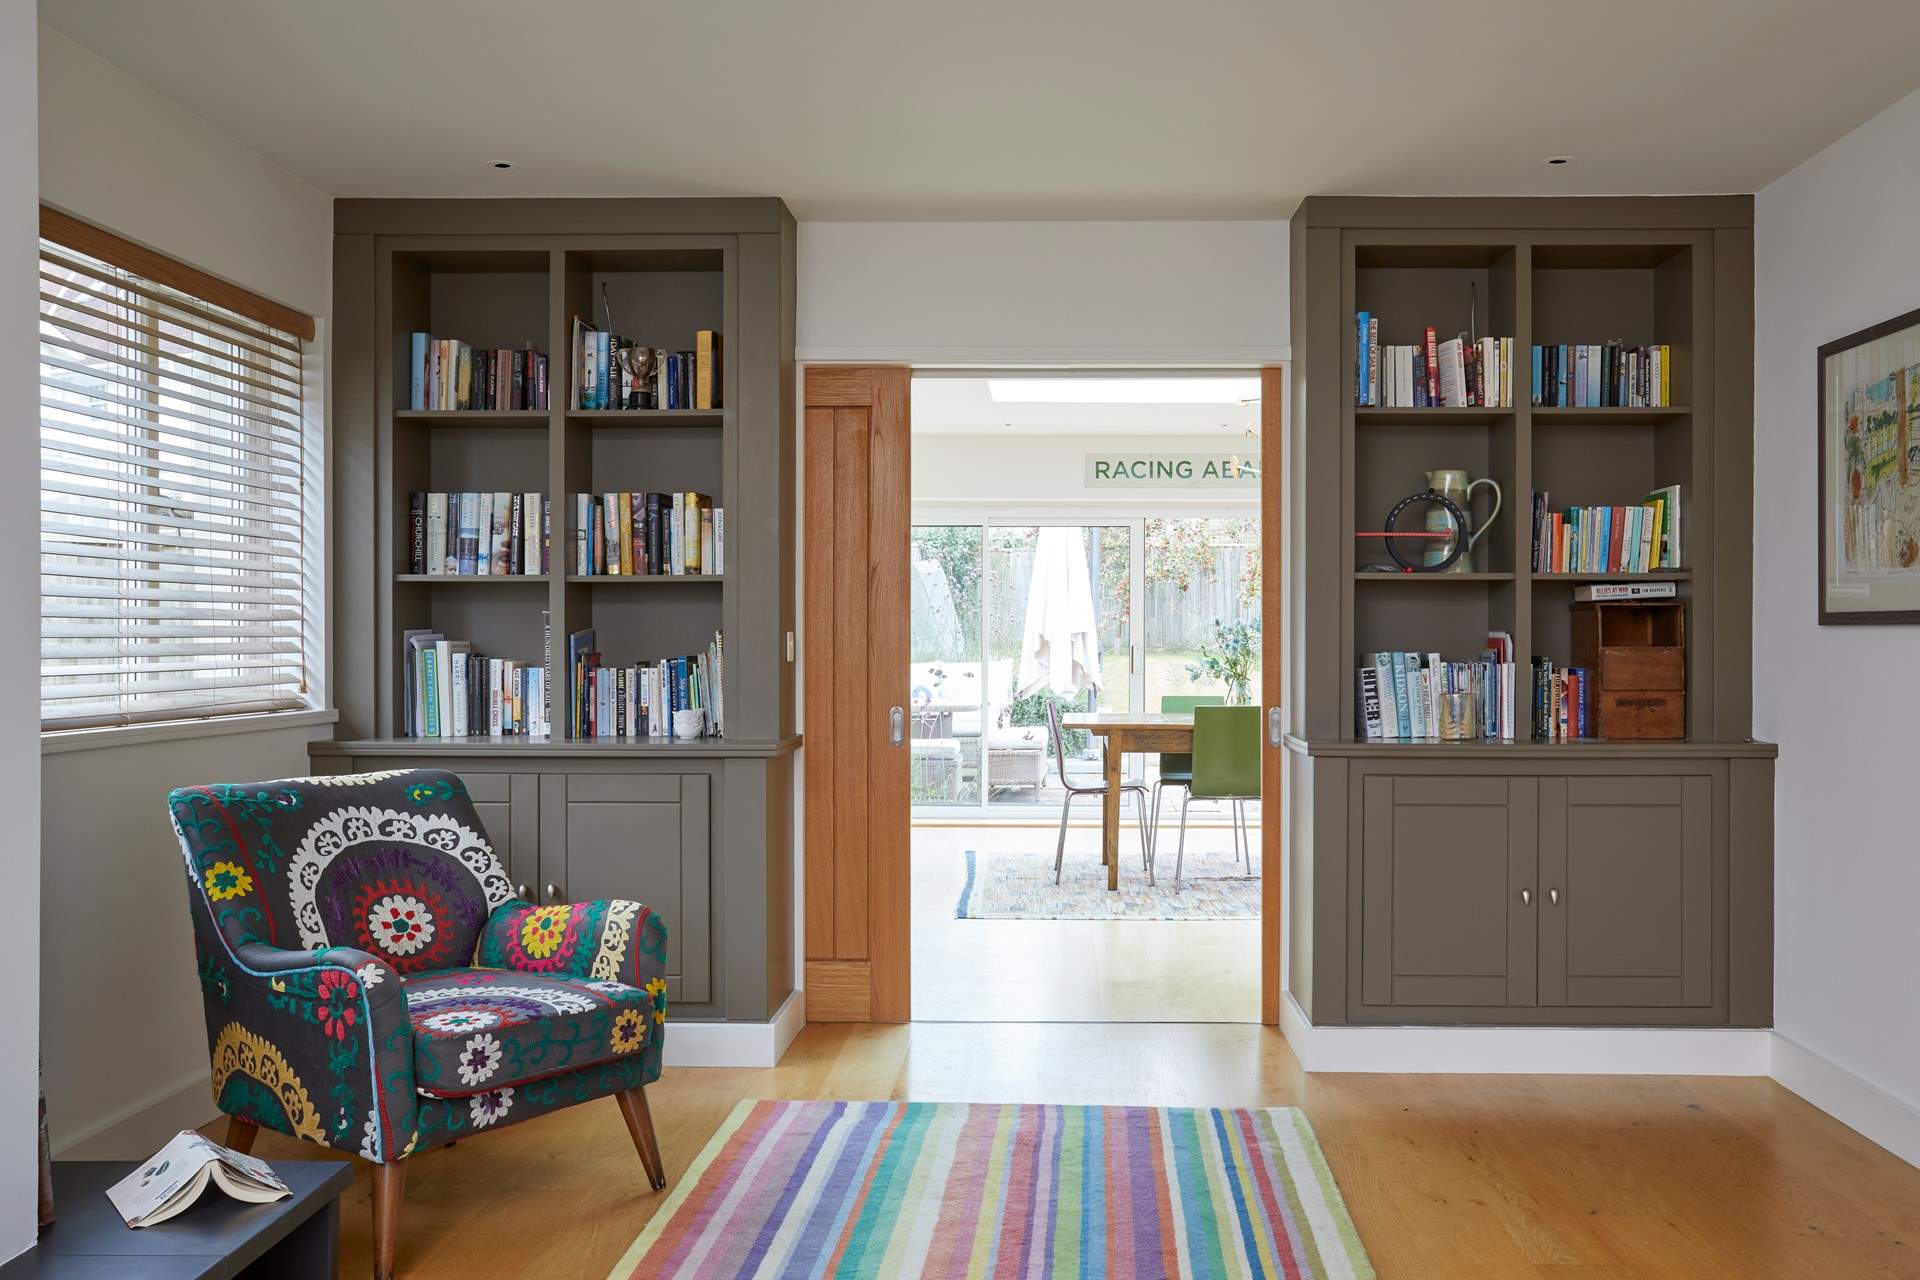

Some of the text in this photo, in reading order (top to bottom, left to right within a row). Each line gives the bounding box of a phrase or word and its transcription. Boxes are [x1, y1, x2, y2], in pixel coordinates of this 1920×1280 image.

[1096, 461, 1192, 479] RACING
[414, 517, 422, 562] CHURCHILL
[1363, 670, 1380, 721] HITLER
[1395, 664, 1408, 712] KIDSON
